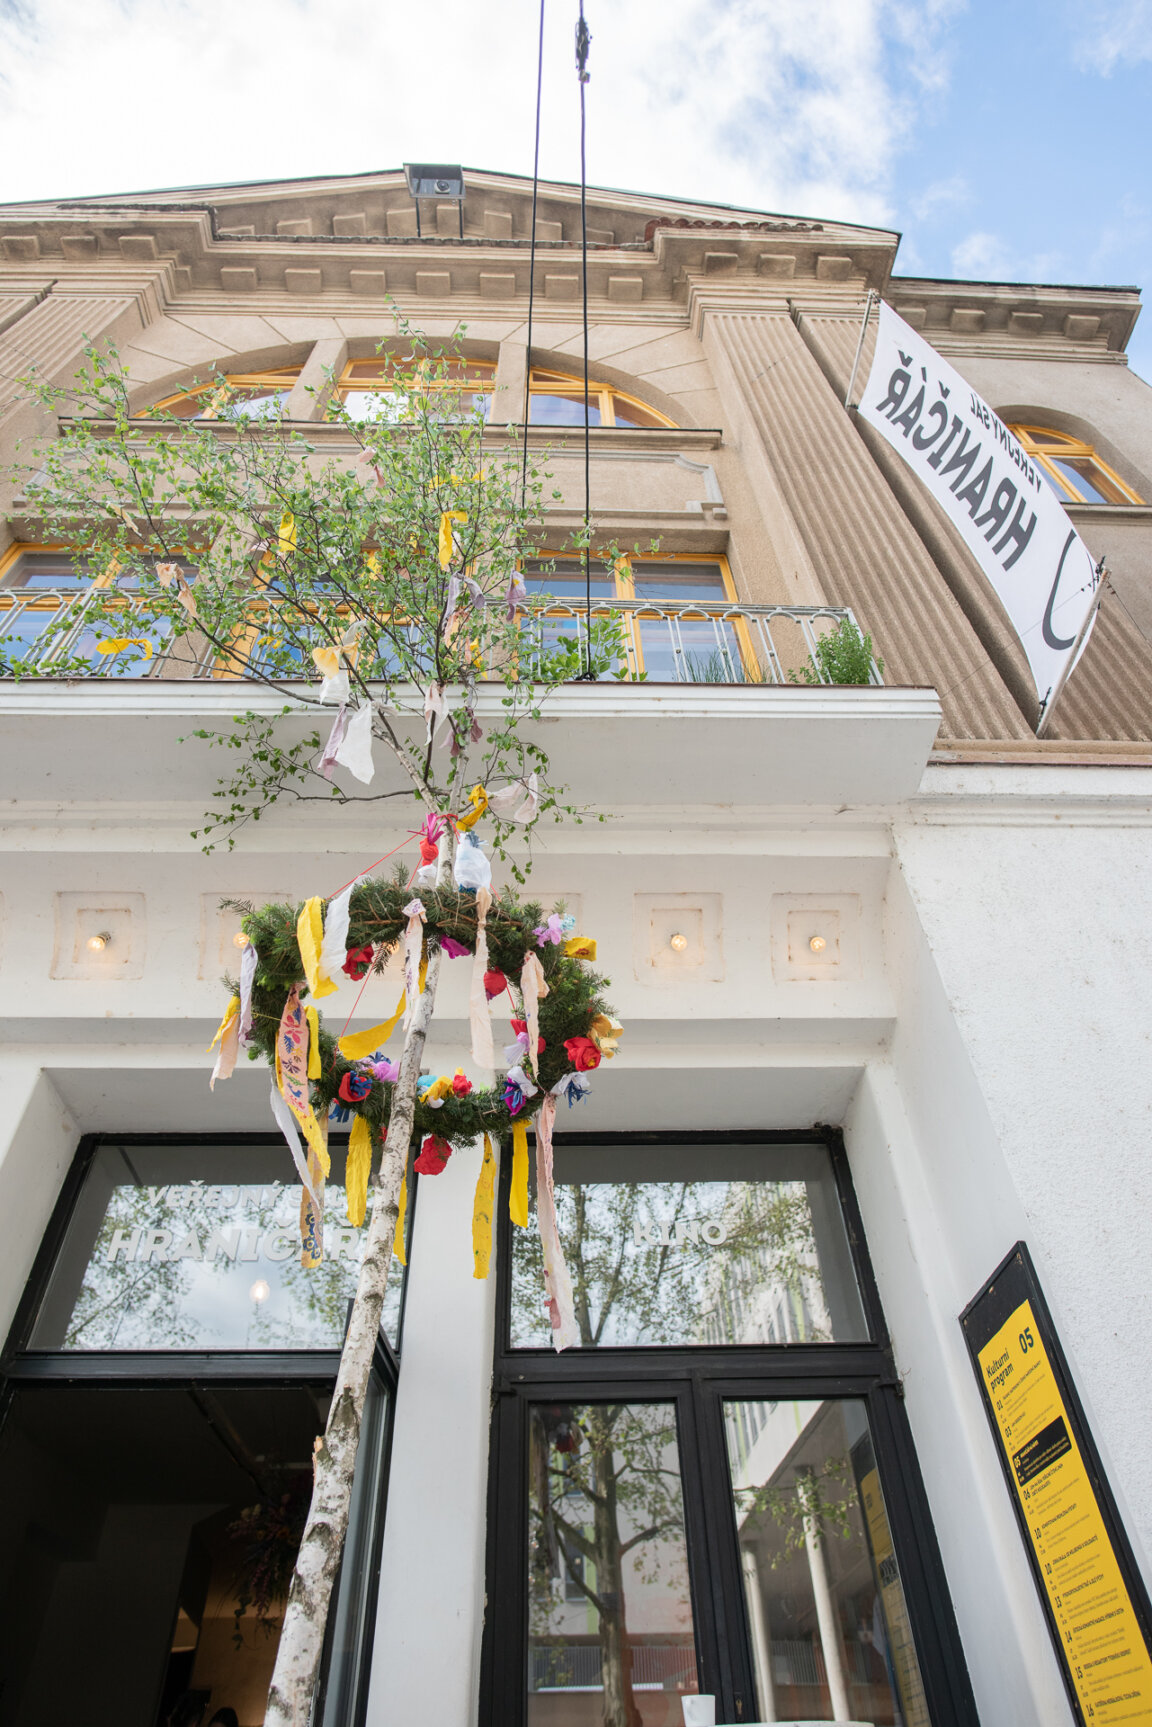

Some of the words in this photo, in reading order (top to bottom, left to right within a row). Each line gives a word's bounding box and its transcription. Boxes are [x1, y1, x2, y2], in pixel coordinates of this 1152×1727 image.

[147, 1180, 285, 1209] VEŘEJNÝ
[287, 1183, 344, 1209] SL
[106, 1218, 361, 1262] HRANIČŘ
[633, 1220, 728, 1247] KINO
[1018, 1326, 1034, 1354] 05
[986, 1347, 1010, 1378] Kulturní
[990, 1363, 1014, 1394] program
